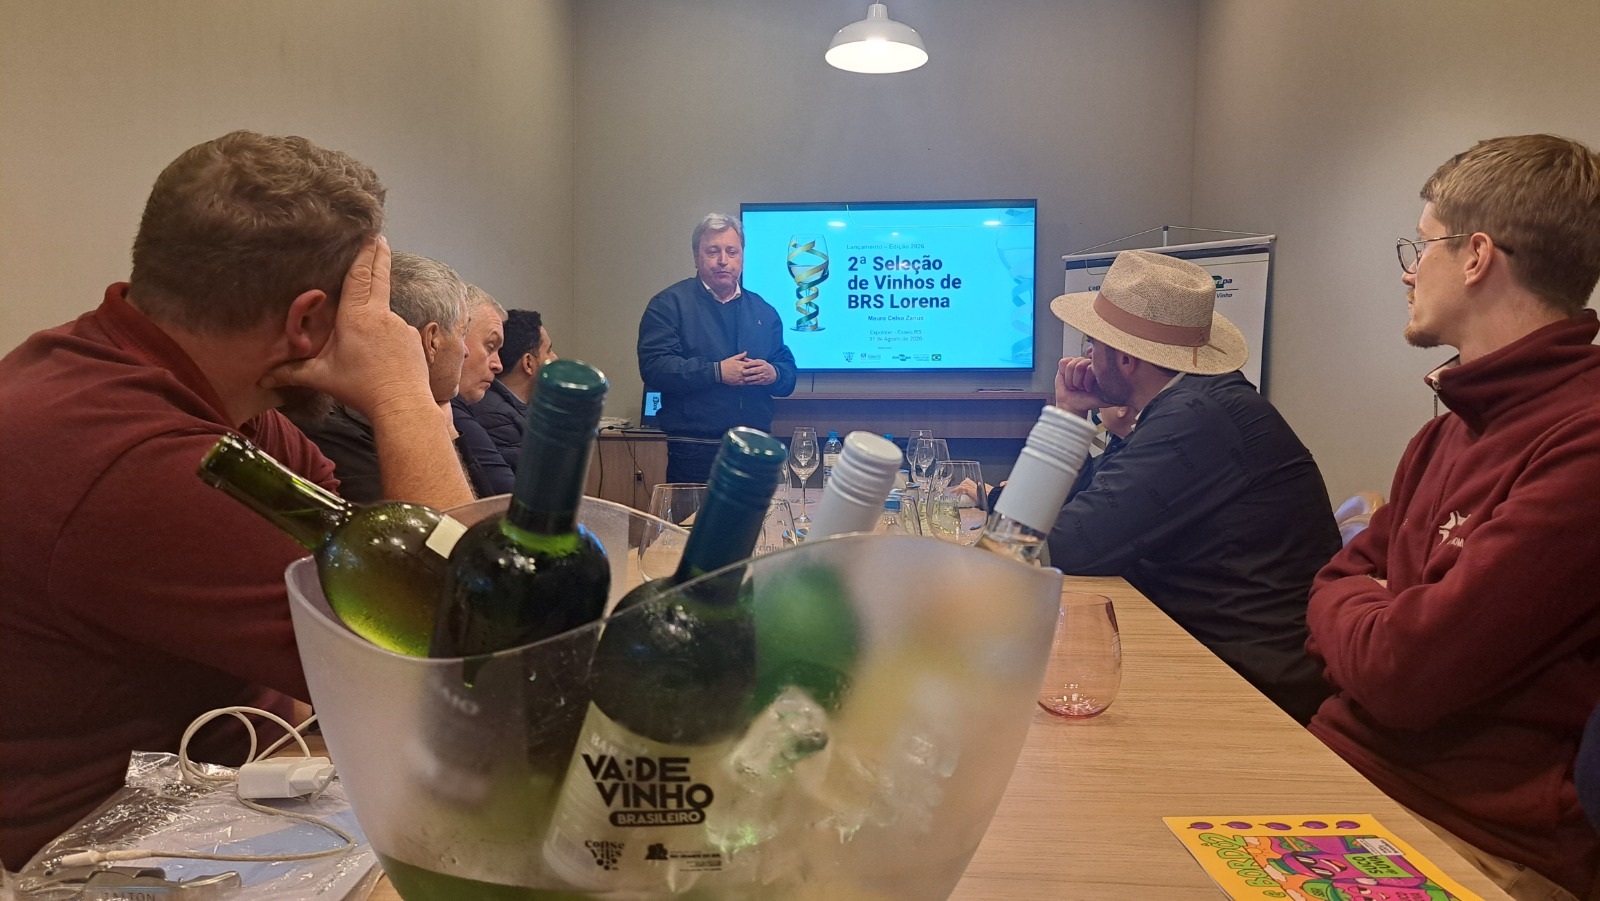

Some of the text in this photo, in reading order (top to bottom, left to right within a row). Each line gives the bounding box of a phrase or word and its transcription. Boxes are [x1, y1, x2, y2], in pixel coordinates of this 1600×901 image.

[847, 254, 943, 274] 2ª Seleção
[847, 274, 962, 290] de Vinhos de
[847, 293, 951, 309] BRS Lorena
[595, 782, 714, 810] VINHO
[616, 810, 701, 825] BRASILEIRO
